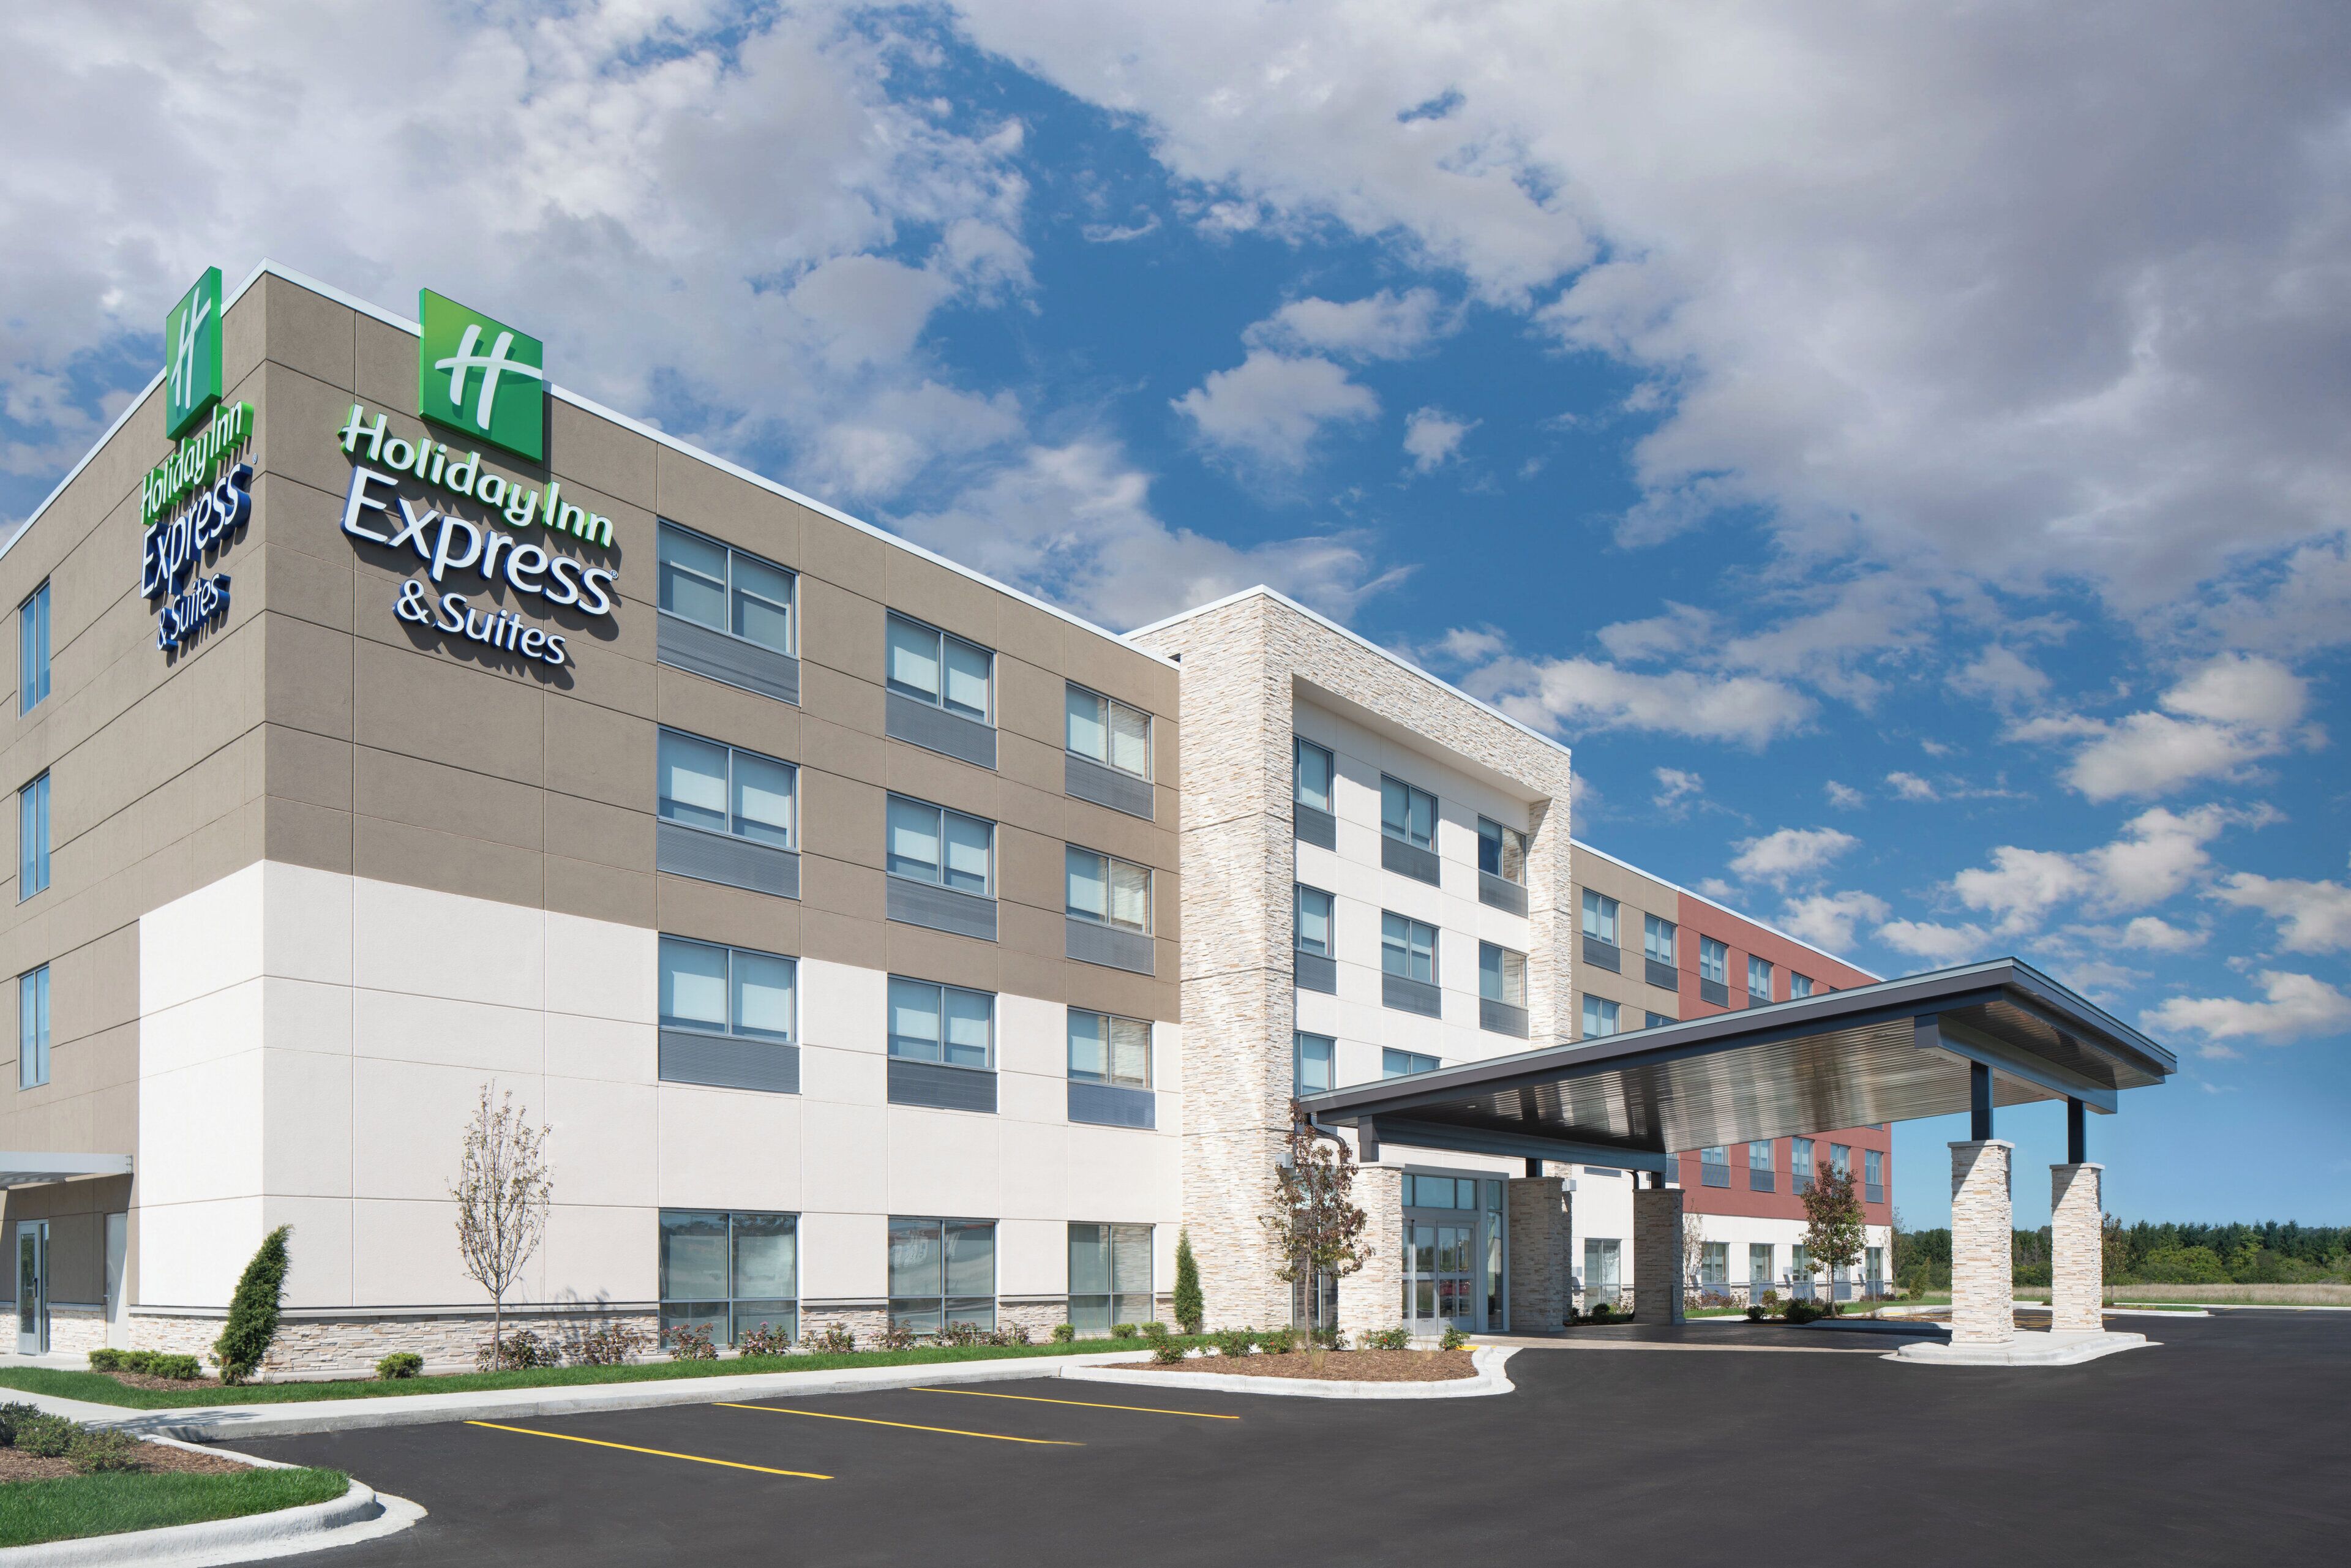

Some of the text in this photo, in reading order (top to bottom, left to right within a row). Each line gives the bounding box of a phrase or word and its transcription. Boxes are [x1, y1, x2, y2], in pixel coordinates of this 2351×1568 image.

[140, 400, 248, 526] Holiday Inn
[339, 403, 613, 549] Holiday Inn
[157, 573, 224, 651] & Suites
[393, 578, 567, 666] & Suites
